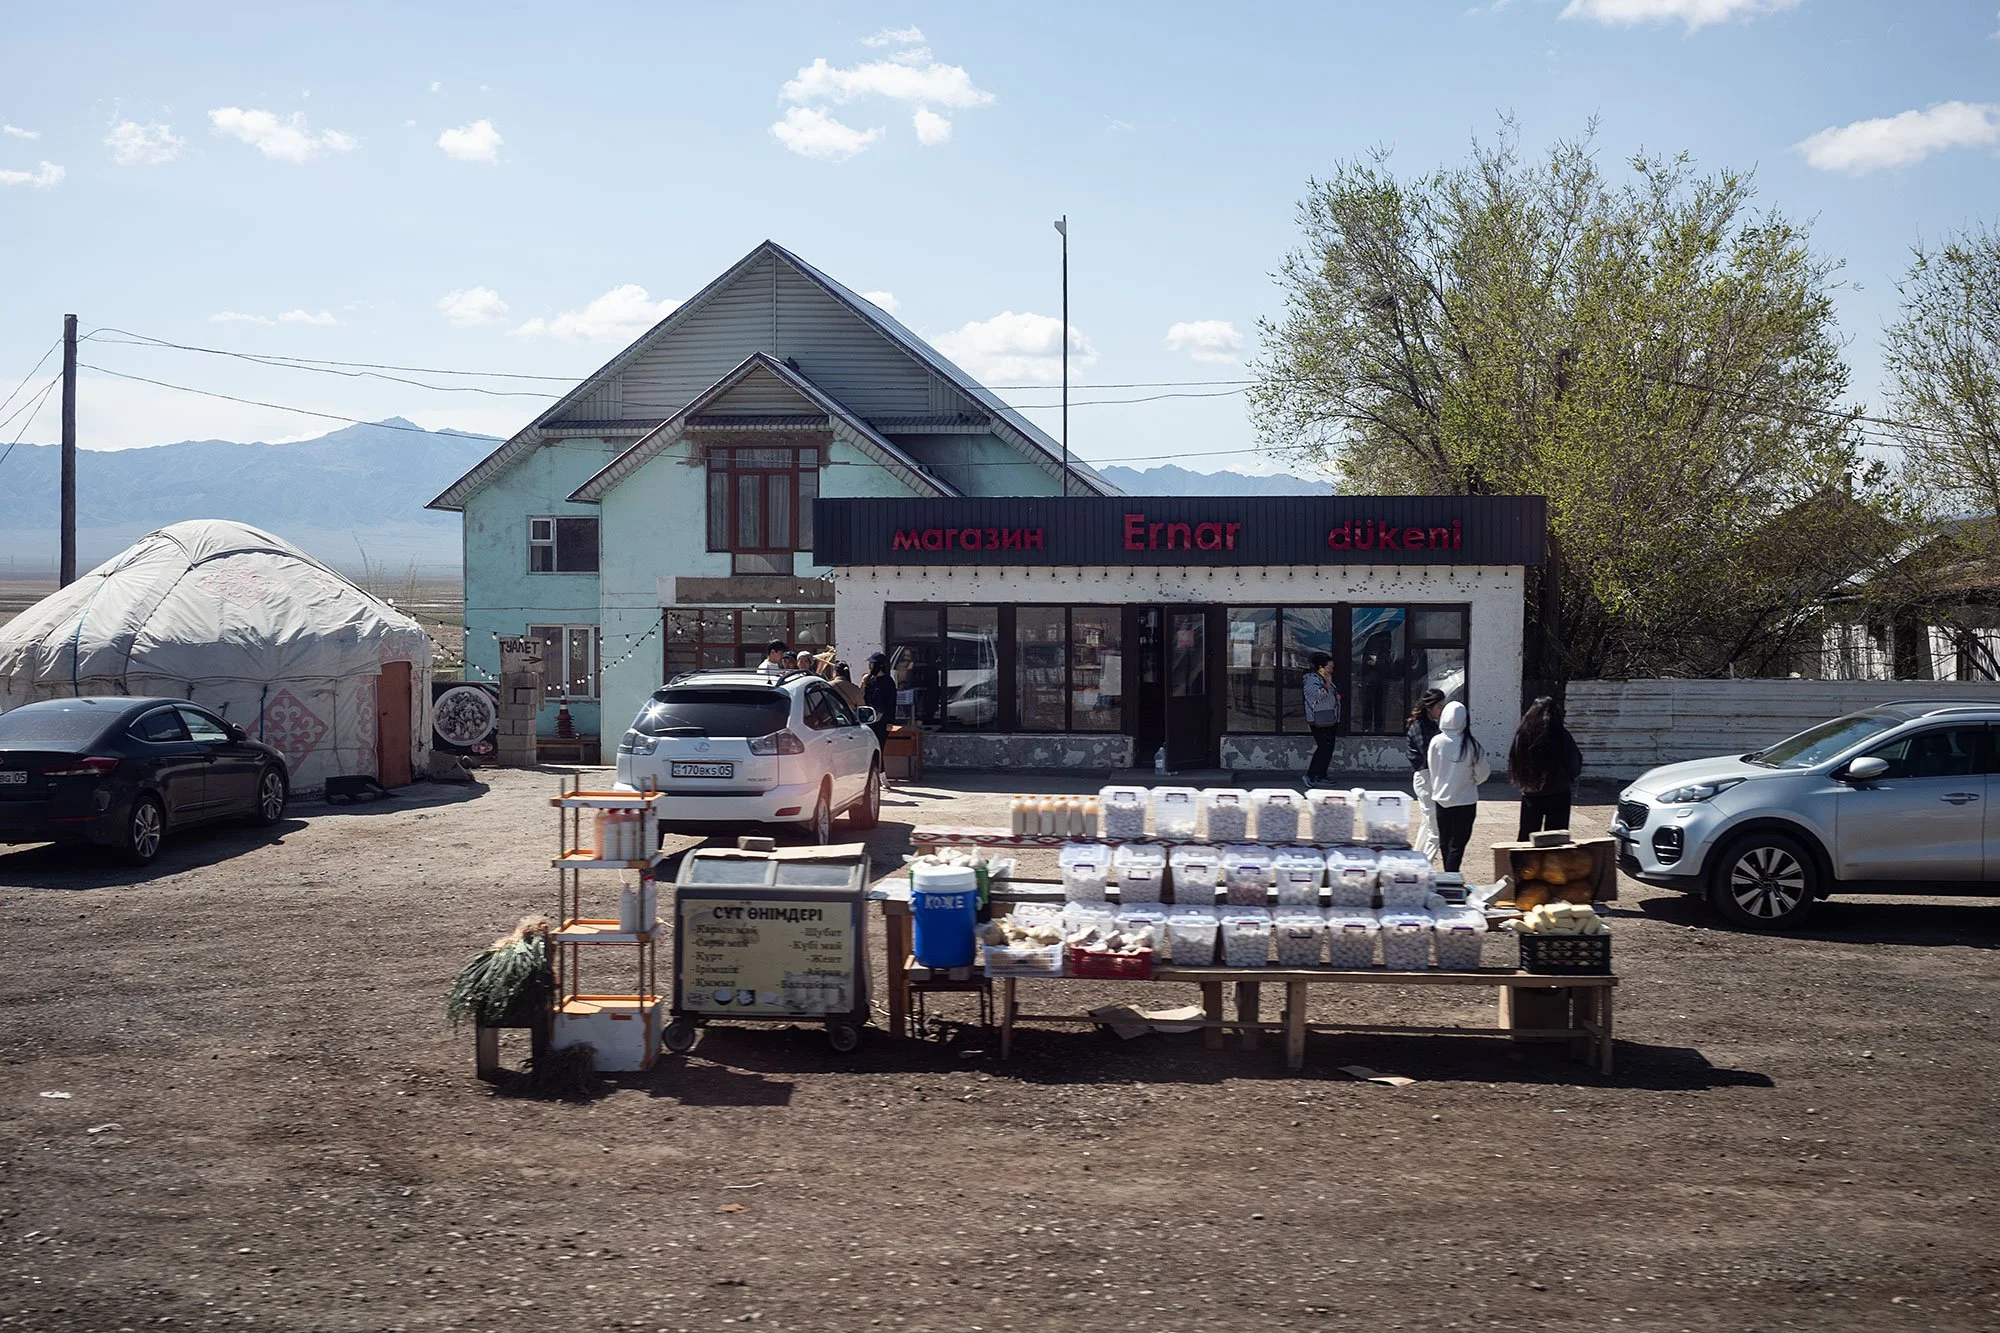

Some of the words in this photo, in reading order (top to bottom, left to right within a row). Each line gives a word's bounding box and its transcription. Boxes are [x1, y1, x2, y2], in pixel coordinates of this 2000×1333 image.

[892, 528, 1044, 550] магазин
[1124, 513, 1241, 550] Ernar
[1328, 519, 1462, 550] dükeni
[499, 640, 540, 654] ТУАЛЕТ
[747, 907, 823, 924] ӨНІМДЕРІ
